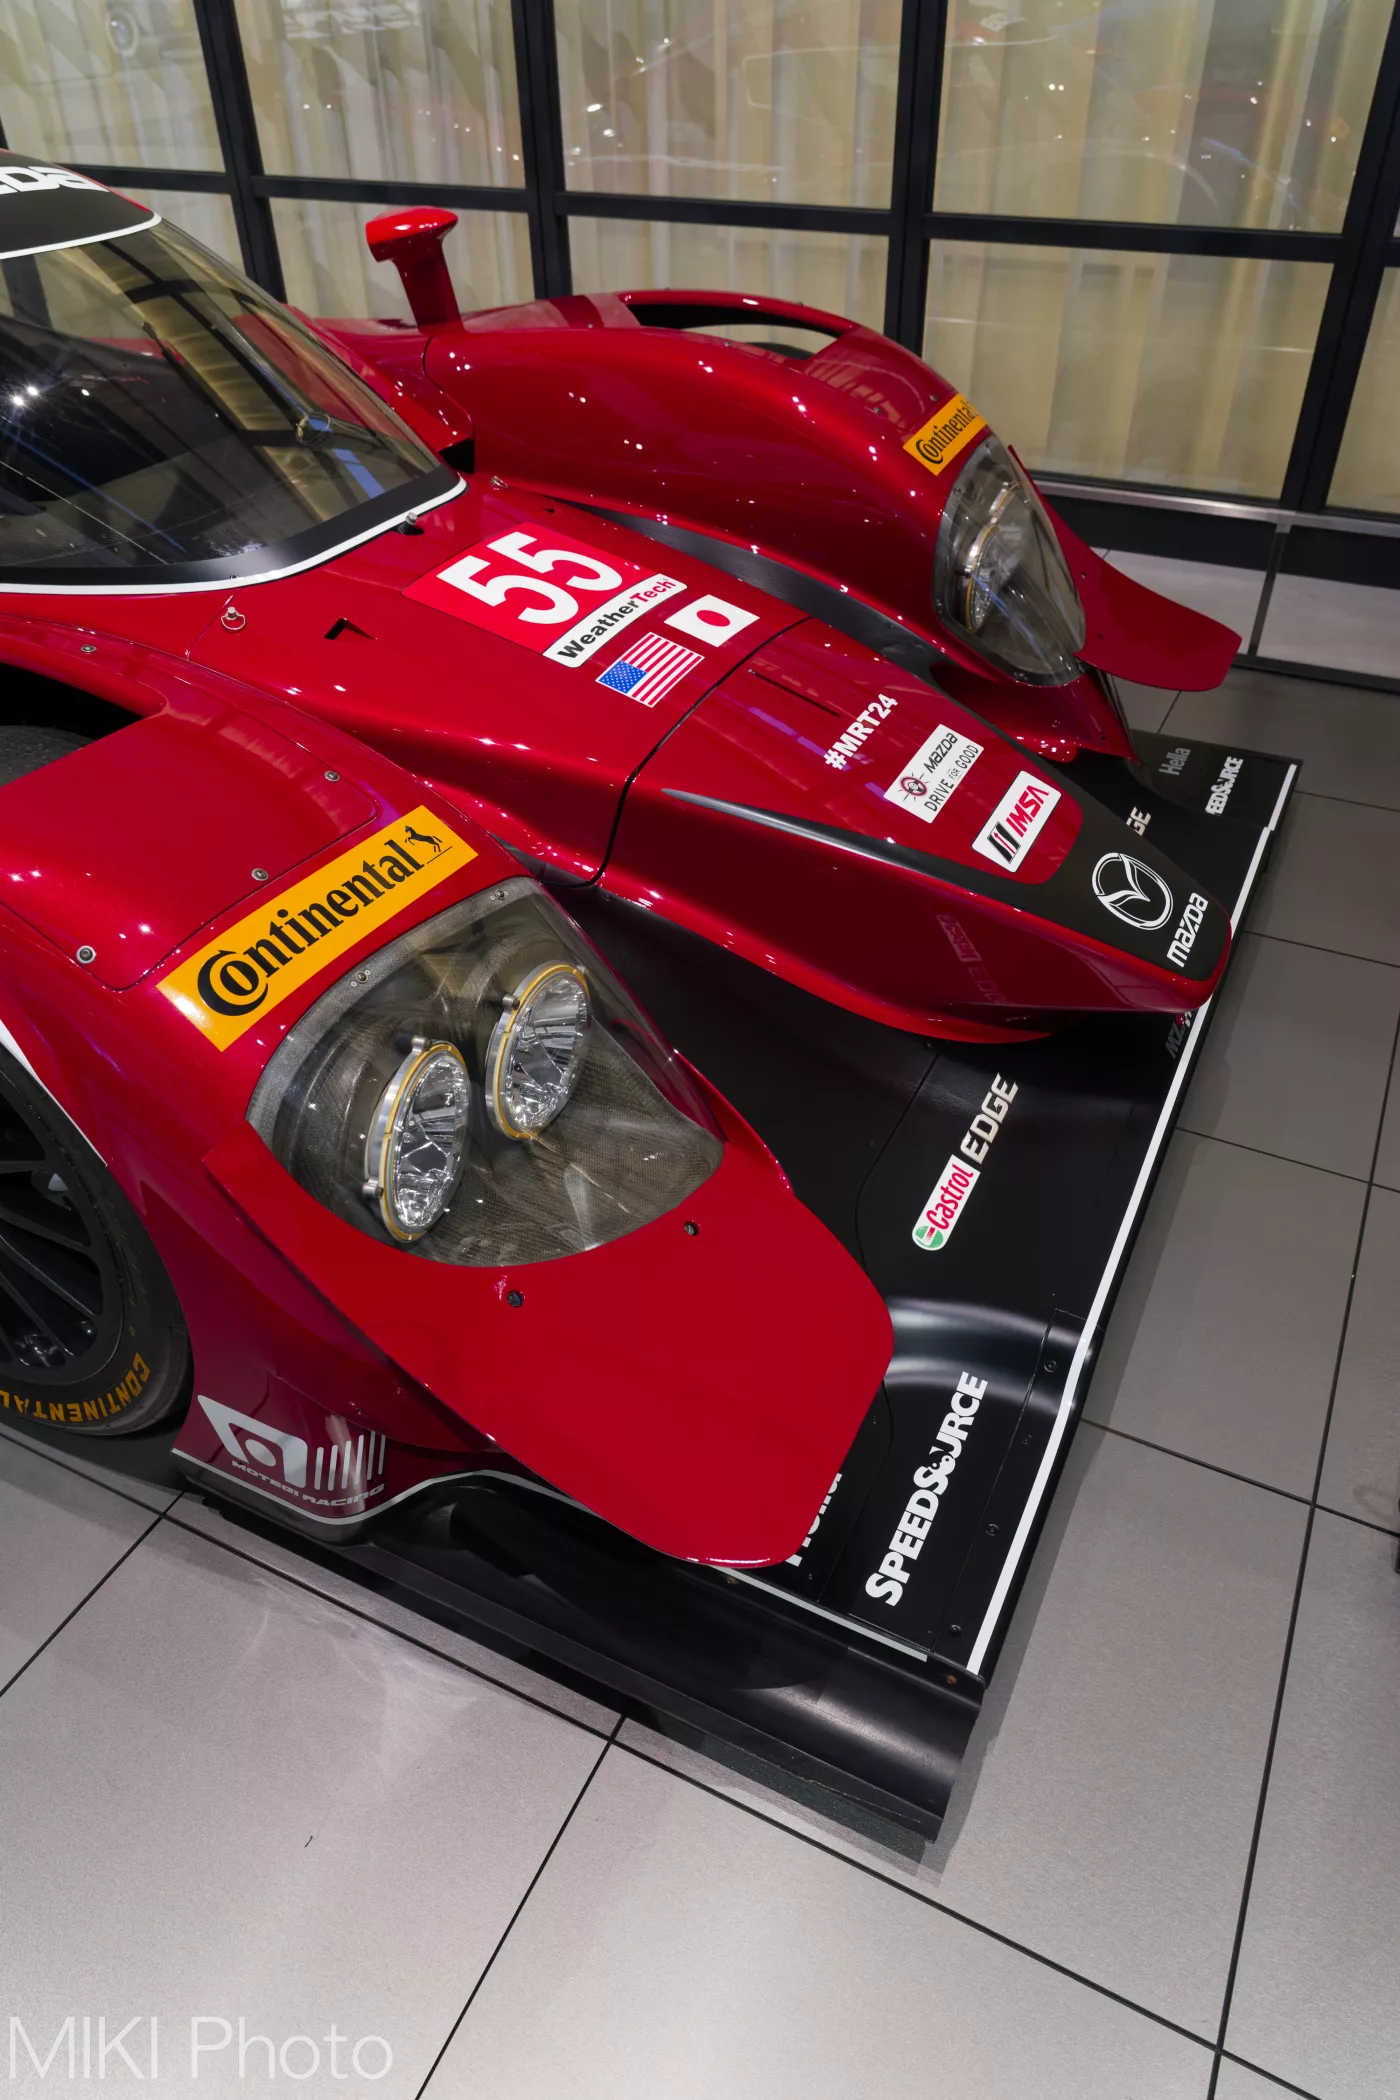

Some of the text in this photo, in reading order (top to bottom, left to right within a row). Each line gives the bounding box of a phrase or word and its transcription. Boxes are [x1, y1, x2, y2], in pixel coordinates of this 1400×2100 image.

[436, 531, 623, 624] 55
[557, 578, 677, 660] WeatherTech
[823, 693, 898, 770] #MRT24
[1158, 748, 1191, 776] Hella
[924, 744, 979, 812] DRIVE FOR GOOD
[1005, 785, 1050, 838] IMSA
[197, 839, 425, 1017] Continental
[926, 1072, 1018, 1230] Castrol EDGE
[0, 1352, 150, 1422] CONTINENTAL
